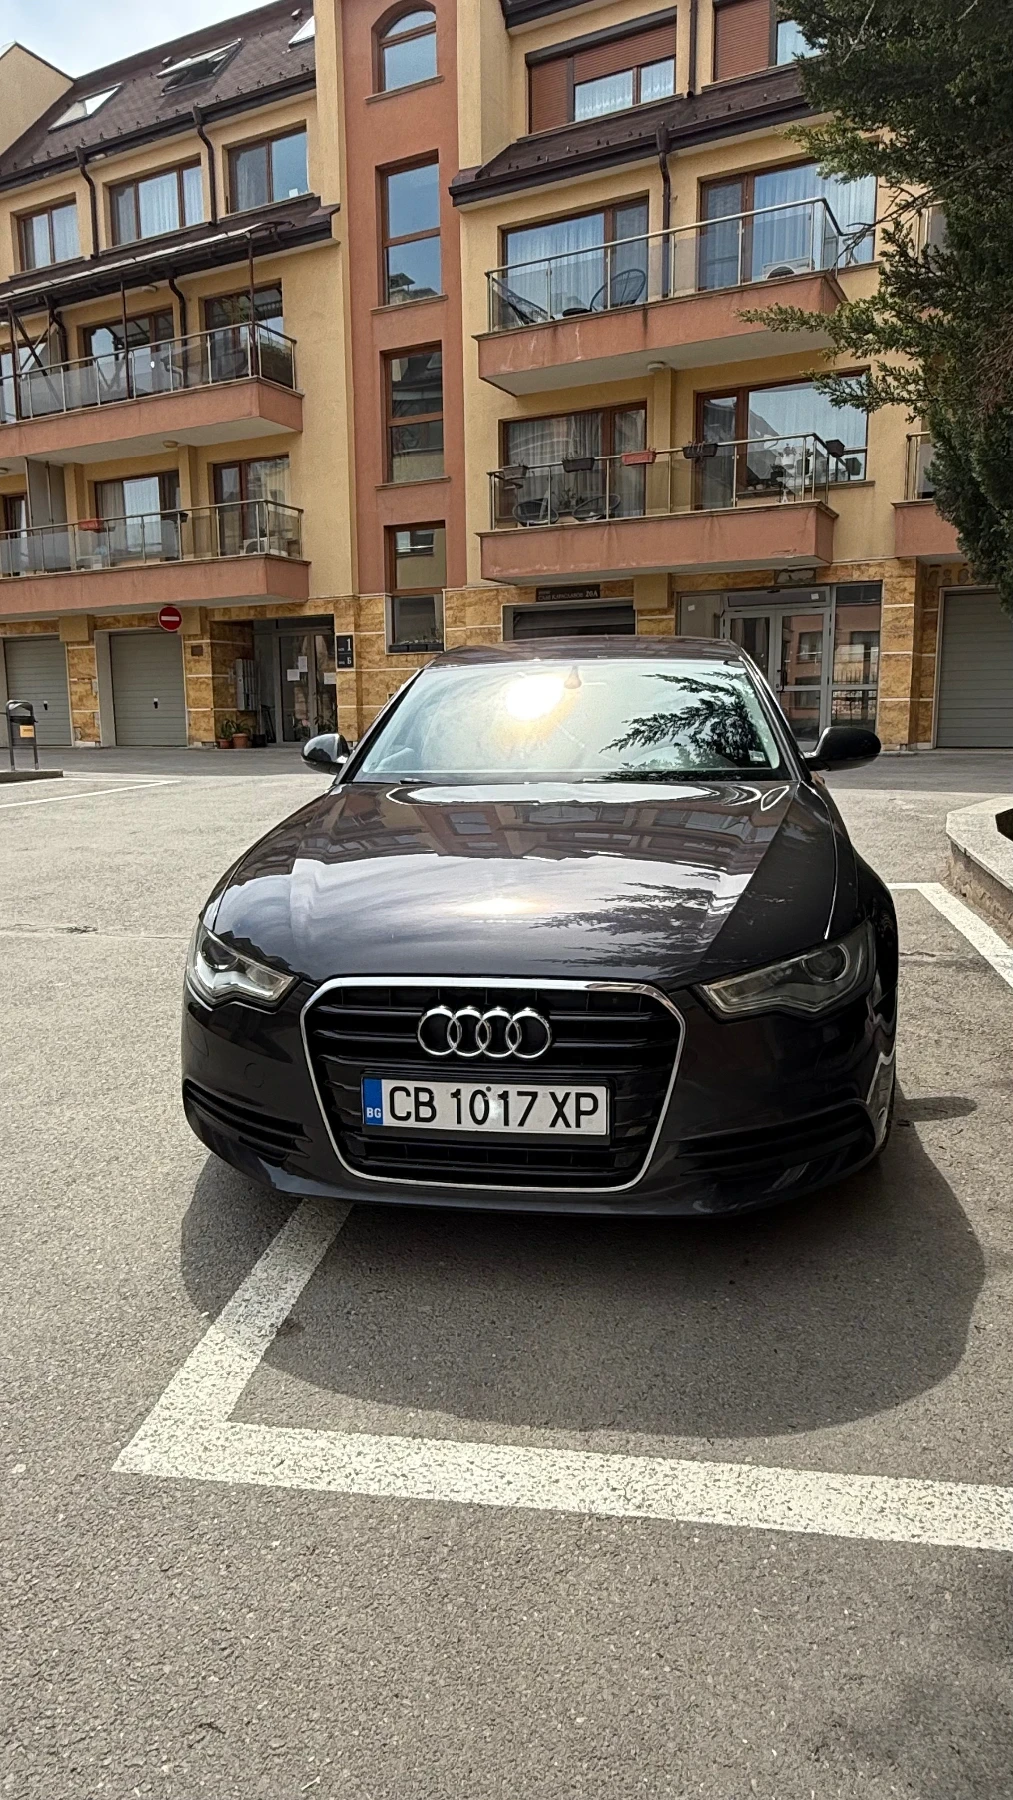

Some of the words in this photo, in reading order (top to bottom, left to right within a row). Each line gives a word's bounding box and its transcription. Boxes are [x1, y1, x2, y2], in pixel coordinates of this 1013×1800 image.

[346, 638, 352, 652] 1
[366, 1107, 382, 1119] BG
[389, 1086, 437, 1123] CB
[450, 1088, 538, 1127] 1017
[549, 1091, 599, 1129] XP
